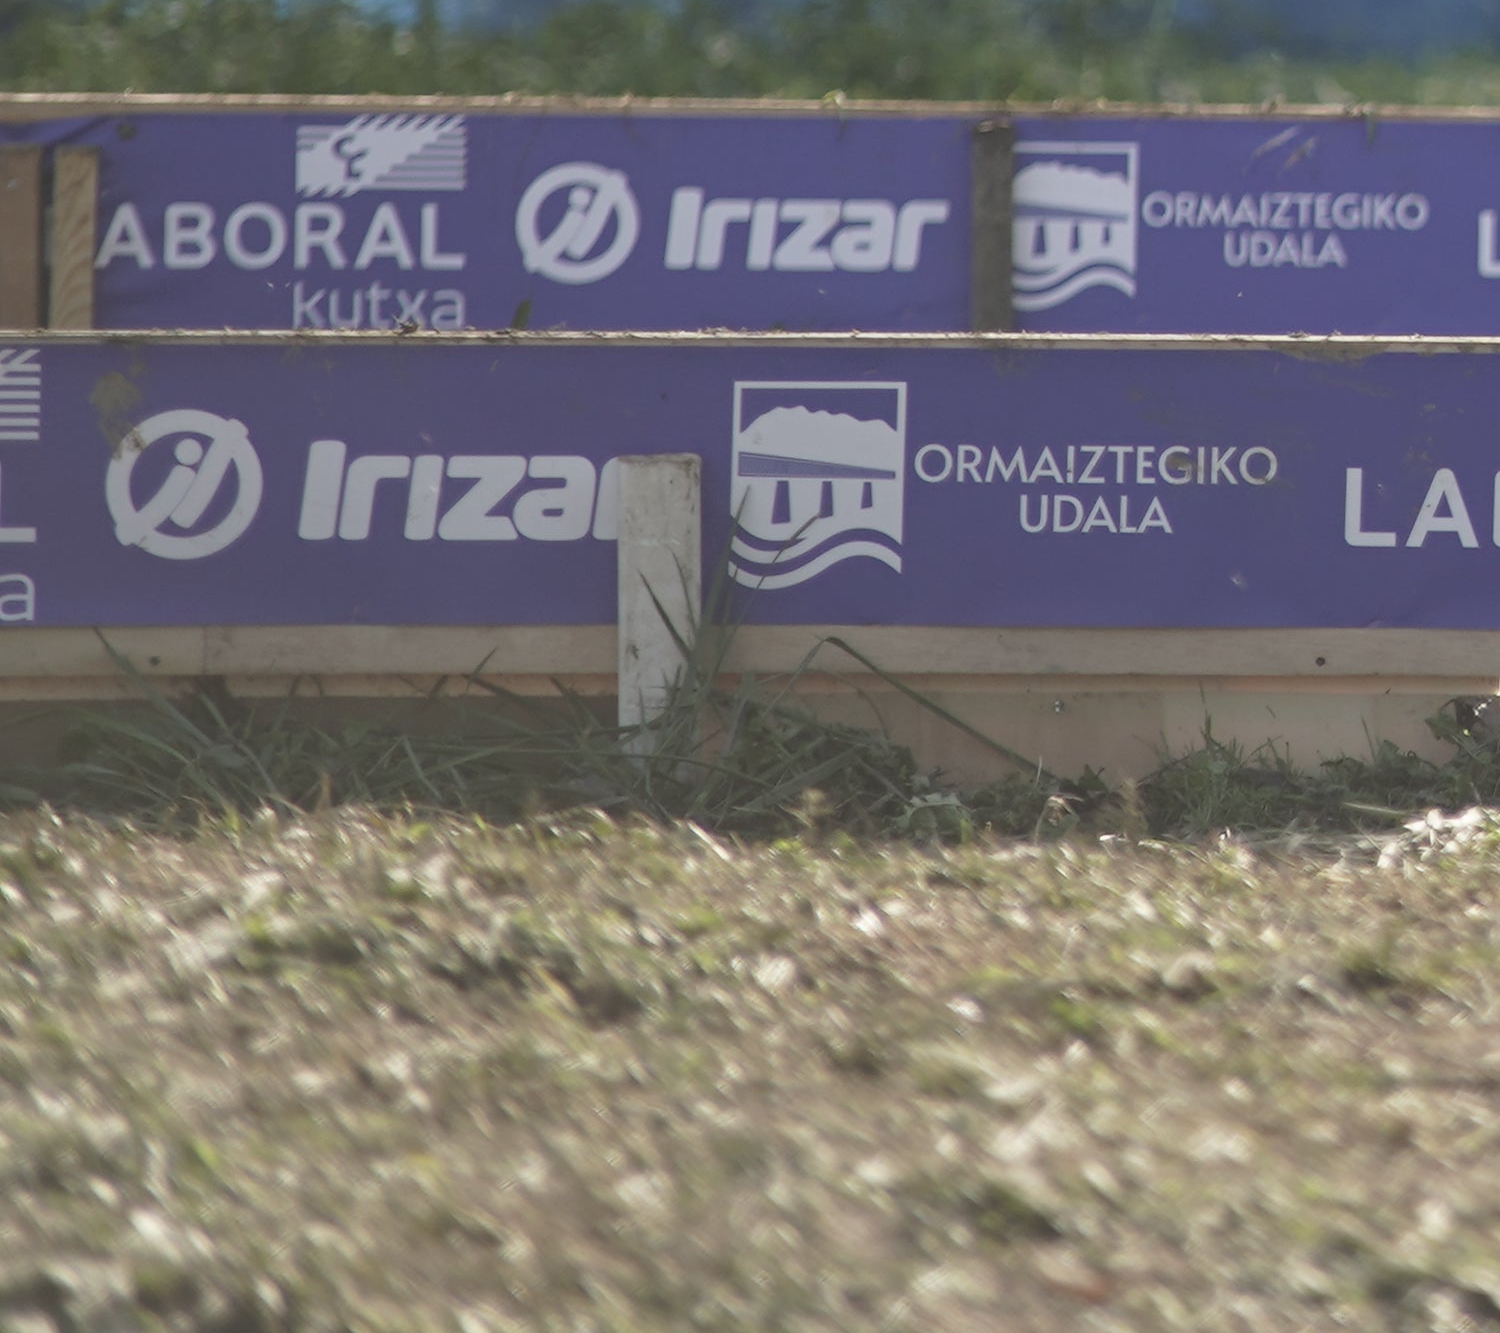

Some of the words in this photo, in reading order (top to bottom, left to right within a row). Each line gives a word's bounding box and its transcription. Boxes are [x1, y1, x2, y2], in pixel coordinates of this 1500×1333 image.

[665, 186, 949, 271] Irizar
[1141, 190, 1429, 230] ORMAIZTEGIKO
[95, 201, 466, 270] ABORAL
[1222, 230, 1346, 268] UDALA
[292, 281, 466, 329] kutxa
[914, 443, 1279, 485] ORMAIZTEGIKO
[1018, 493, 1174, 535] UDALA
